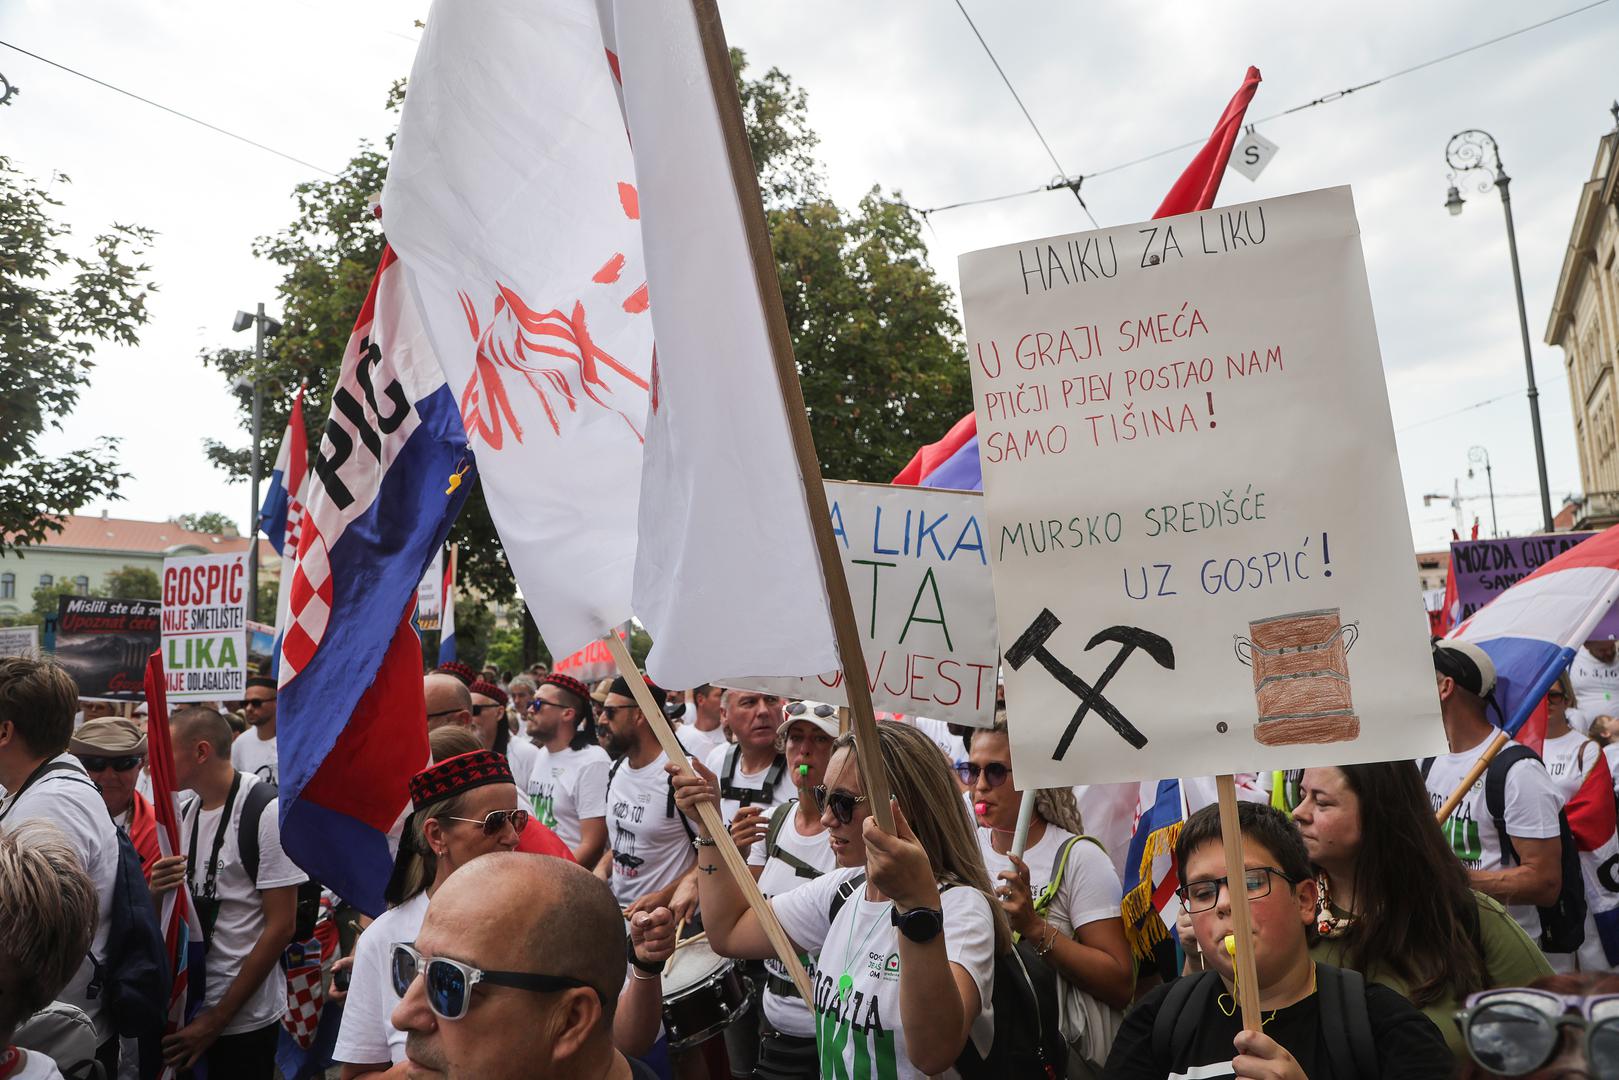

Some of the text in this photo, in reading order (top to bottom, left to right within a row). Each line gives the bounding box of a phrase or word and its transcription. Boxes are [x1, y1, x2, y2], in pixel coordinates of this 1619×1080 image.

[1245, 145, 1259, 165] S
[1018, 207, 1267, 294] HAIKU ZA LIKU
[977, 301, 1209, 379] U GRAJI SMEĆA
[984, 344, 1284, 421] PTIČJI PJEV POSTAO NAM
[986, 391, 1217, 463] SAMO TIŠINA!
[873, 505, 987, 565] LIKA
[999, 484, 1266, 562] MURSKO SREDIŠĆE
[163, 557, 244, 607] GOSPIĆ
[1123, 532, 1333, 600] UZ GOSPIĆ!
[67, 600, 107, 613] Mislili
[109, 603, 128, 614] ste
[130, 603, 145, 615] da
[163, 604, 243, 631] NIJE SMETLIŠTE!
[169, 637, 238, 669] LIKA
[187, 669, 242, 691] ODLAGALIŠTE!
